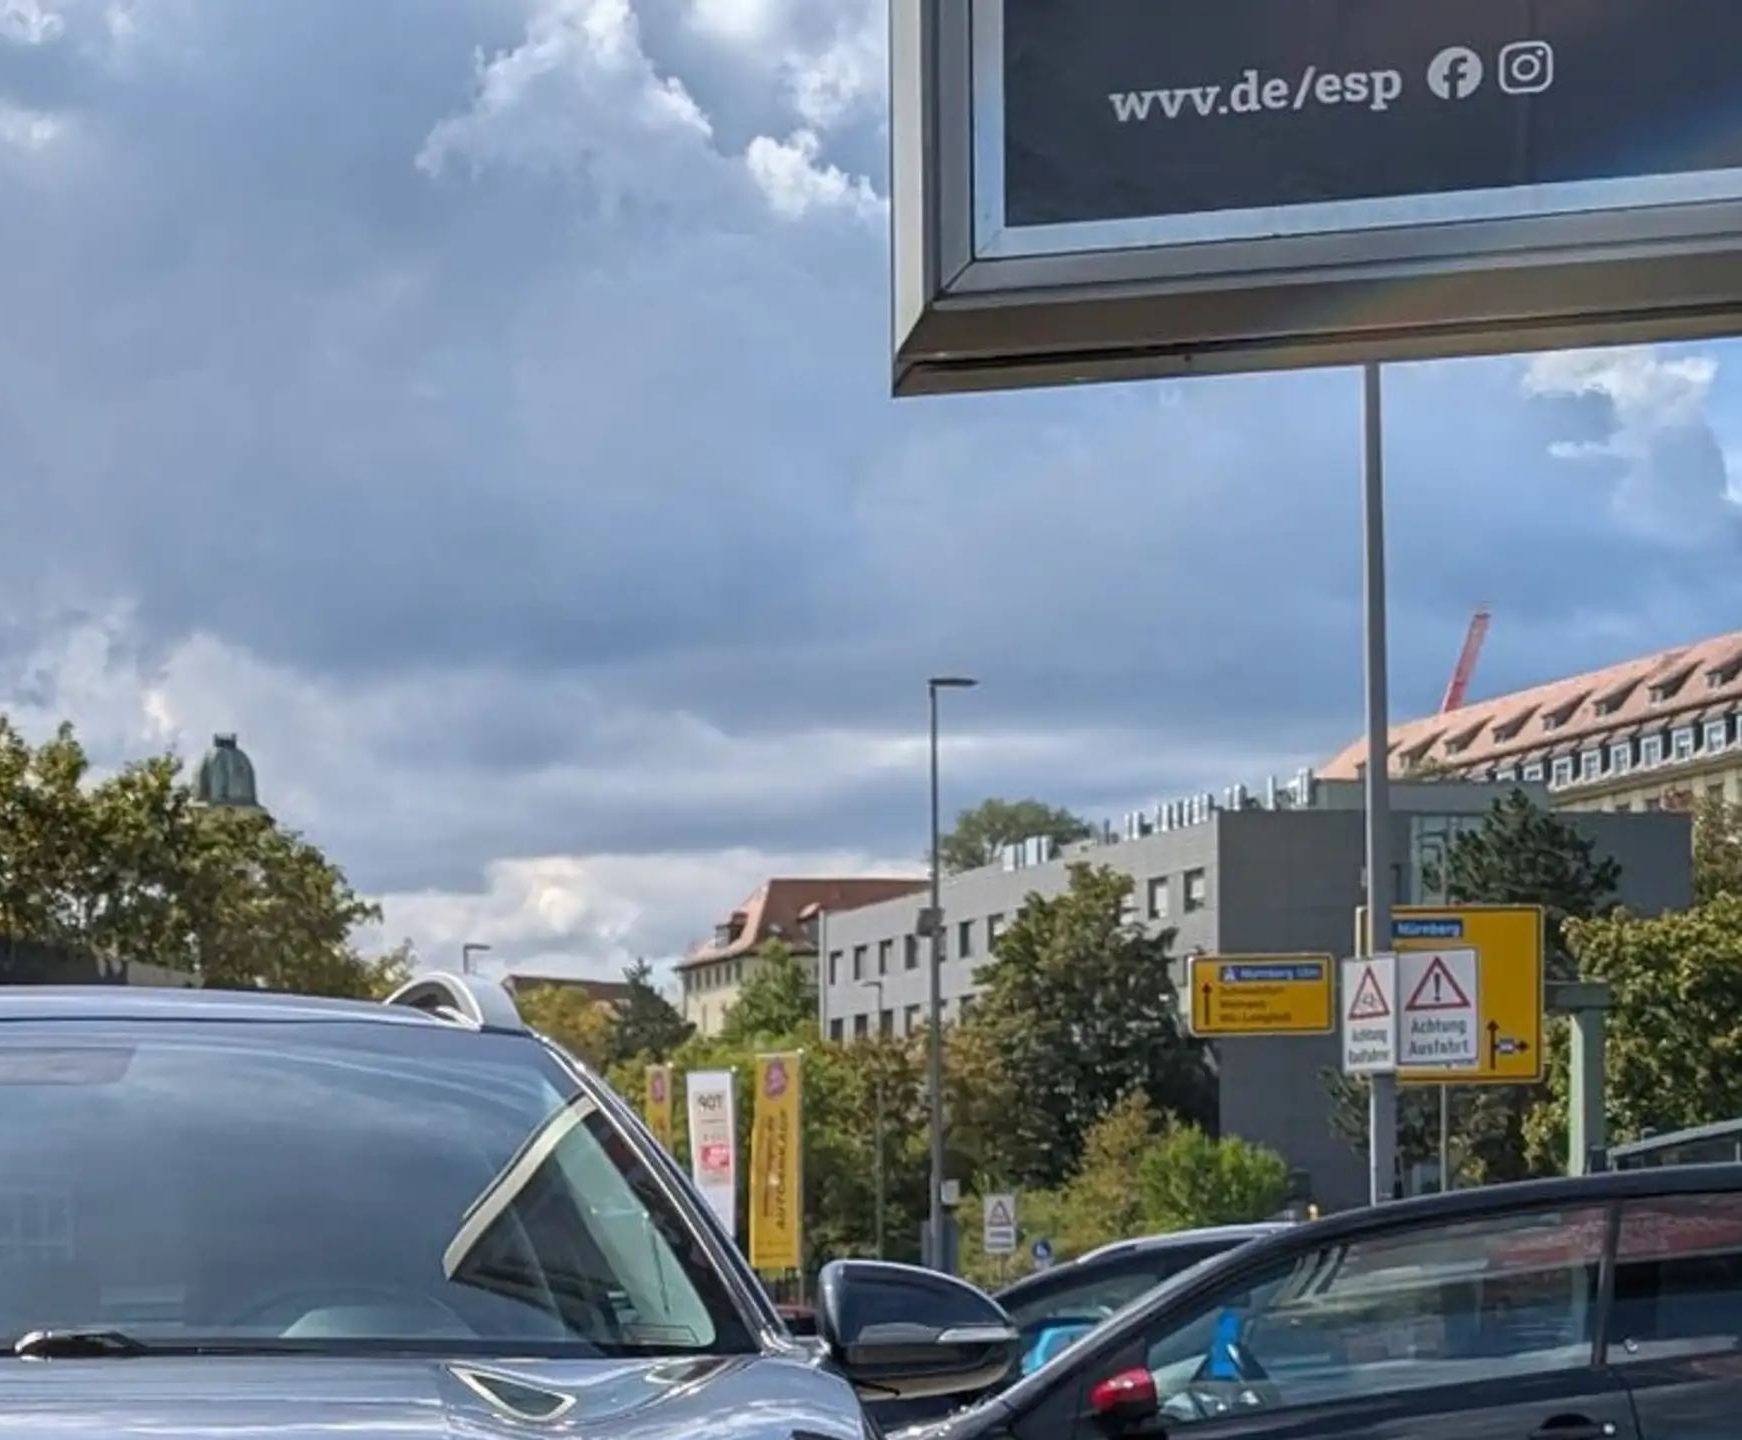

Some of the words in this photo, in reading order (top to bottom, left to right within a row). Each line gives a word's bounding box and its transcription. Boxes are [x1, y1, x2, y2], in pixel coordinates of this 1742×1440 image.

[1109, 66, 1403, 123] wvv.de/esp
[1411, 1018, 1467, 1036] Achtung
[1409, 1038, 1468, 1056] Ausfahrt
